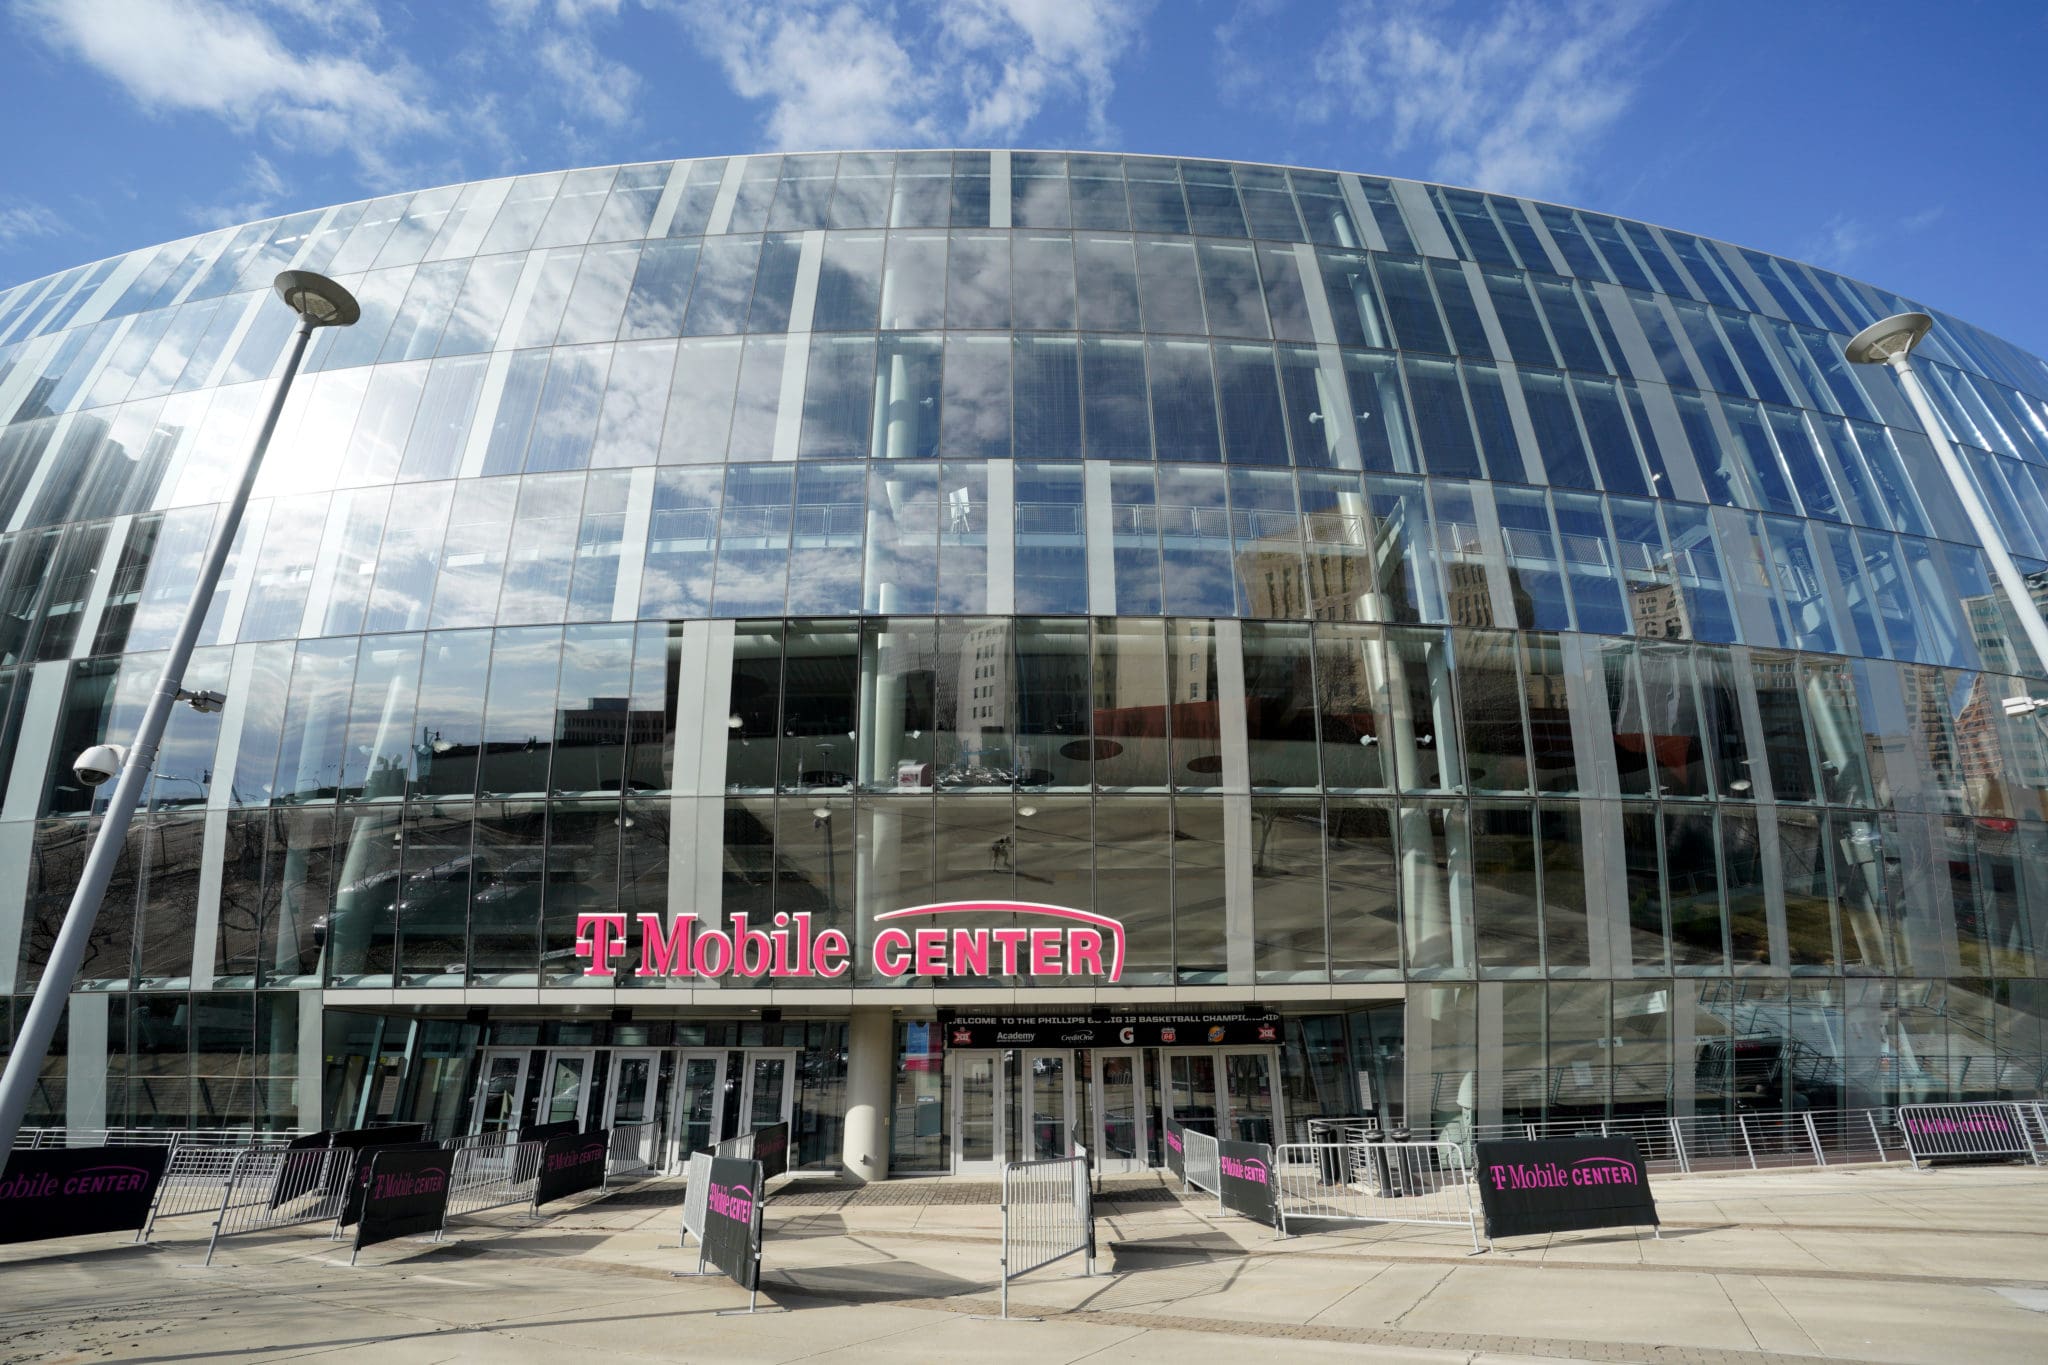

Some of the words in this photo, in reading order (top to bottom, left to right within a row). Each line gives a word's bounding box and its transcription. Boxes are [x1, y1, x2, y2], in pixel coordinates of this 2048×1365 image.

[873, 927, 1106, 977] CENTER
[1001, 1017, 1015, 1025] TO
[1016, 1017, 1036, 1025] THE
[1125, 1016, 1136, 1024] 12
[1139, 1016, 1201, 1024] BASKETBALL
[1203, 1014, 1279, 1022] CHAMPIOHIP
[997, 1031, 1035, 1041] Academy
[1119, 1027, 1135, 1045] G
[414, 1174, 443, 1194] CENTER
[1244, 1165, 1266, 1184] CENTER
[1572, 1167, 1632, 1186] CENTER
[63, 1174, 141, 1196] CENTER
